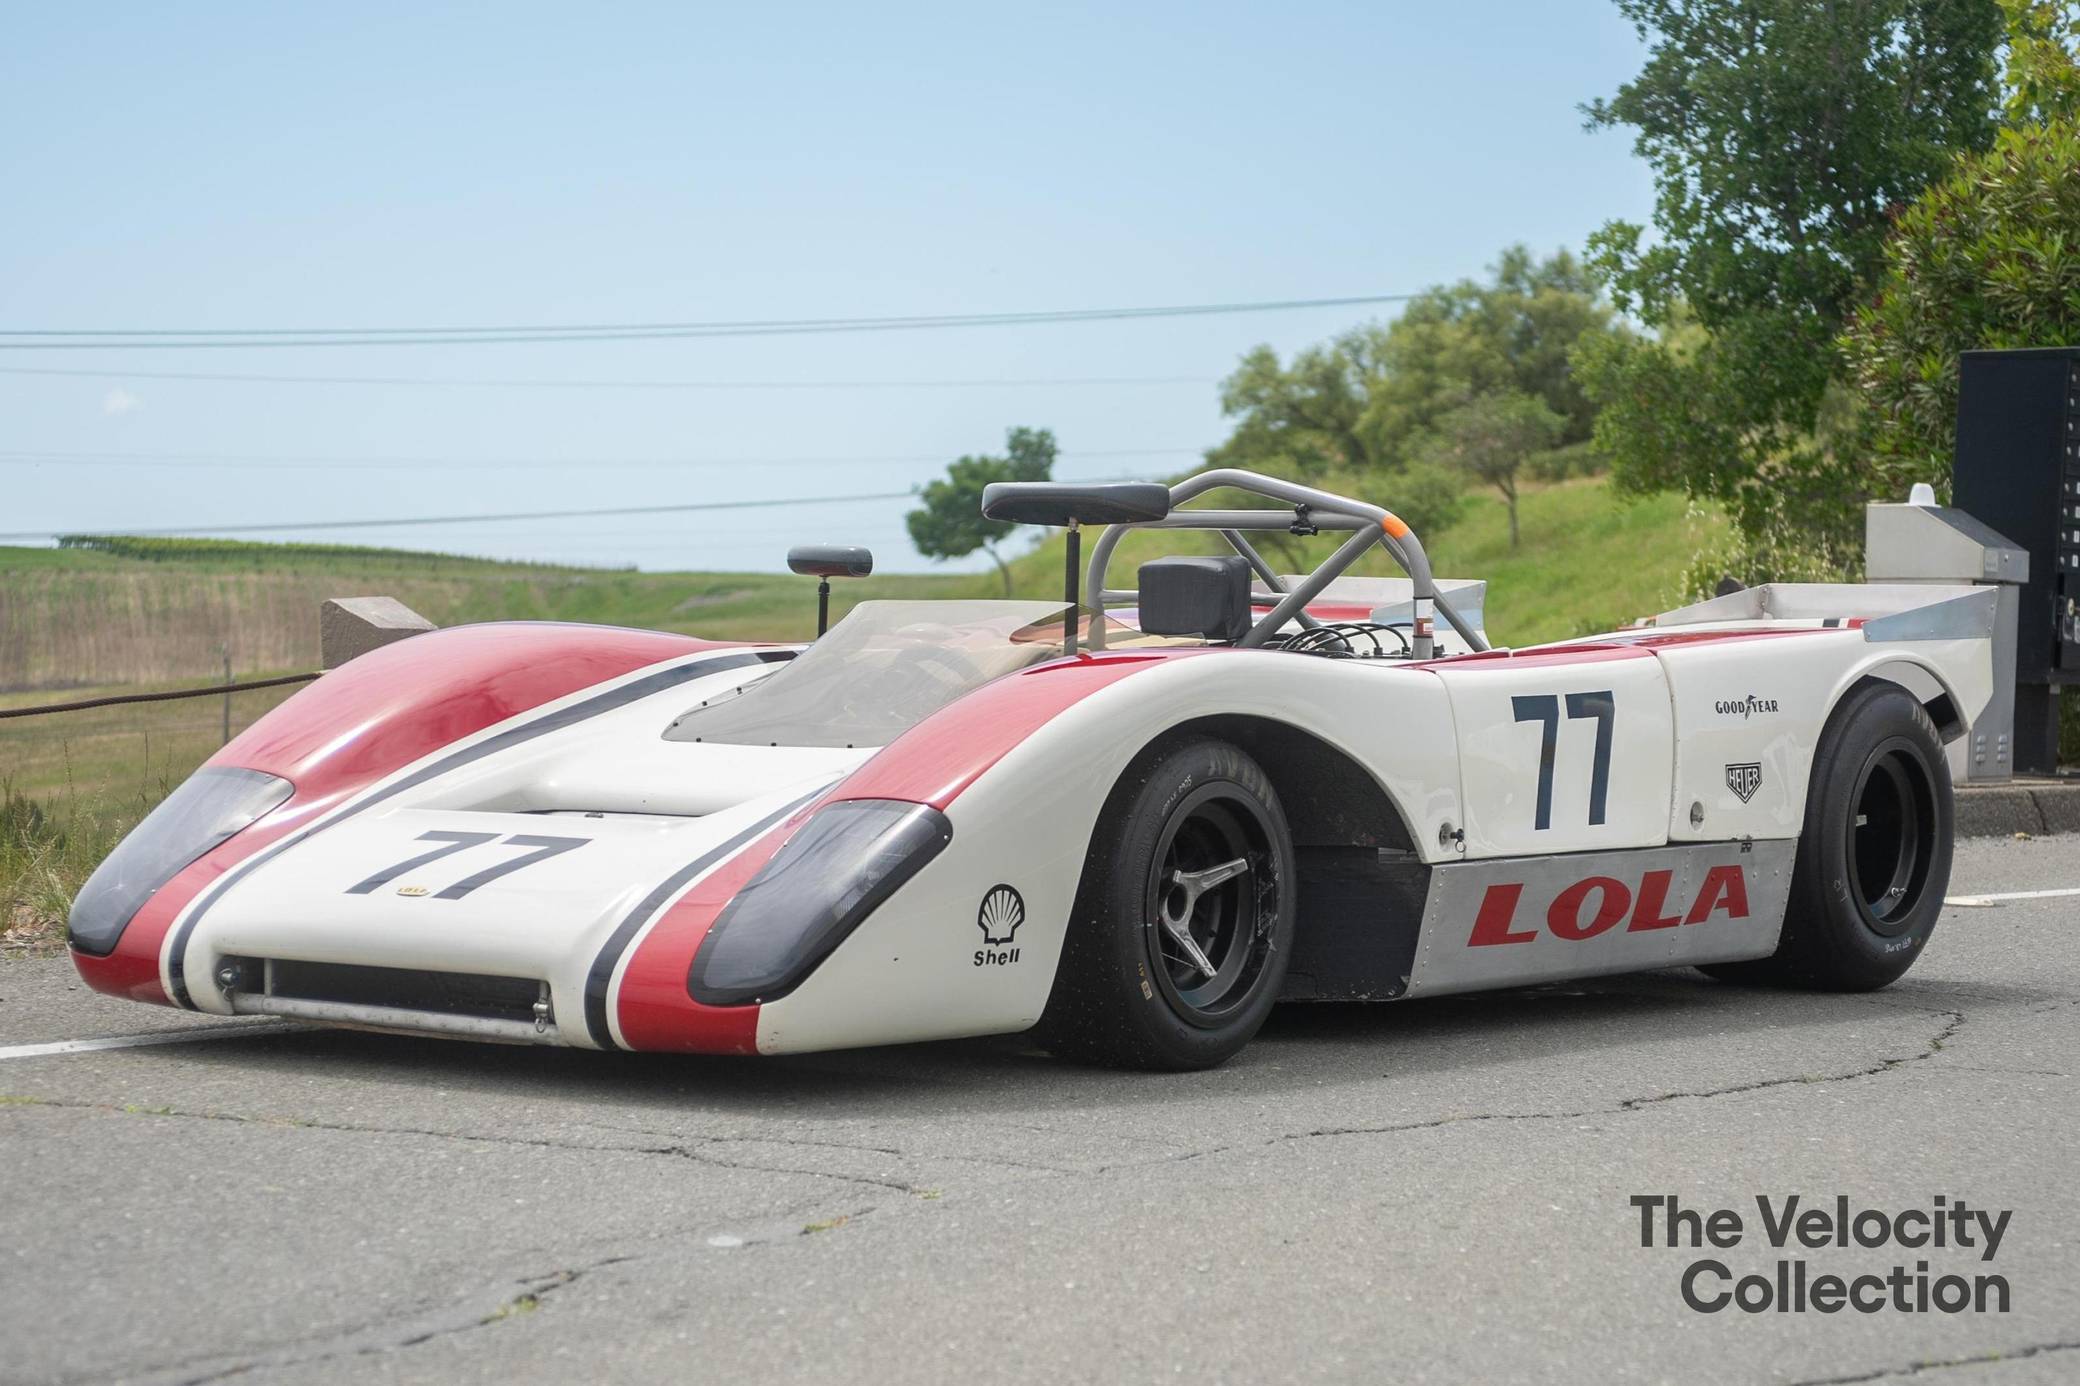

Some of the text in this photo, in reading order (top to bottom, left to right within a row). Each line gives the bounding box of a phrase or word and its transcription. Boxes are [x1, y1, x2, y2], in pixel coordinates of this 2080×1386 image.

[1511, 690, 1616, 831] 77
[1728, 767, 1760, 797] HEUER
[343, 830, 594, 900] 77
[1466, 864, 1752, 947] LOLA
[973, 948, 1021, 967] Shell
